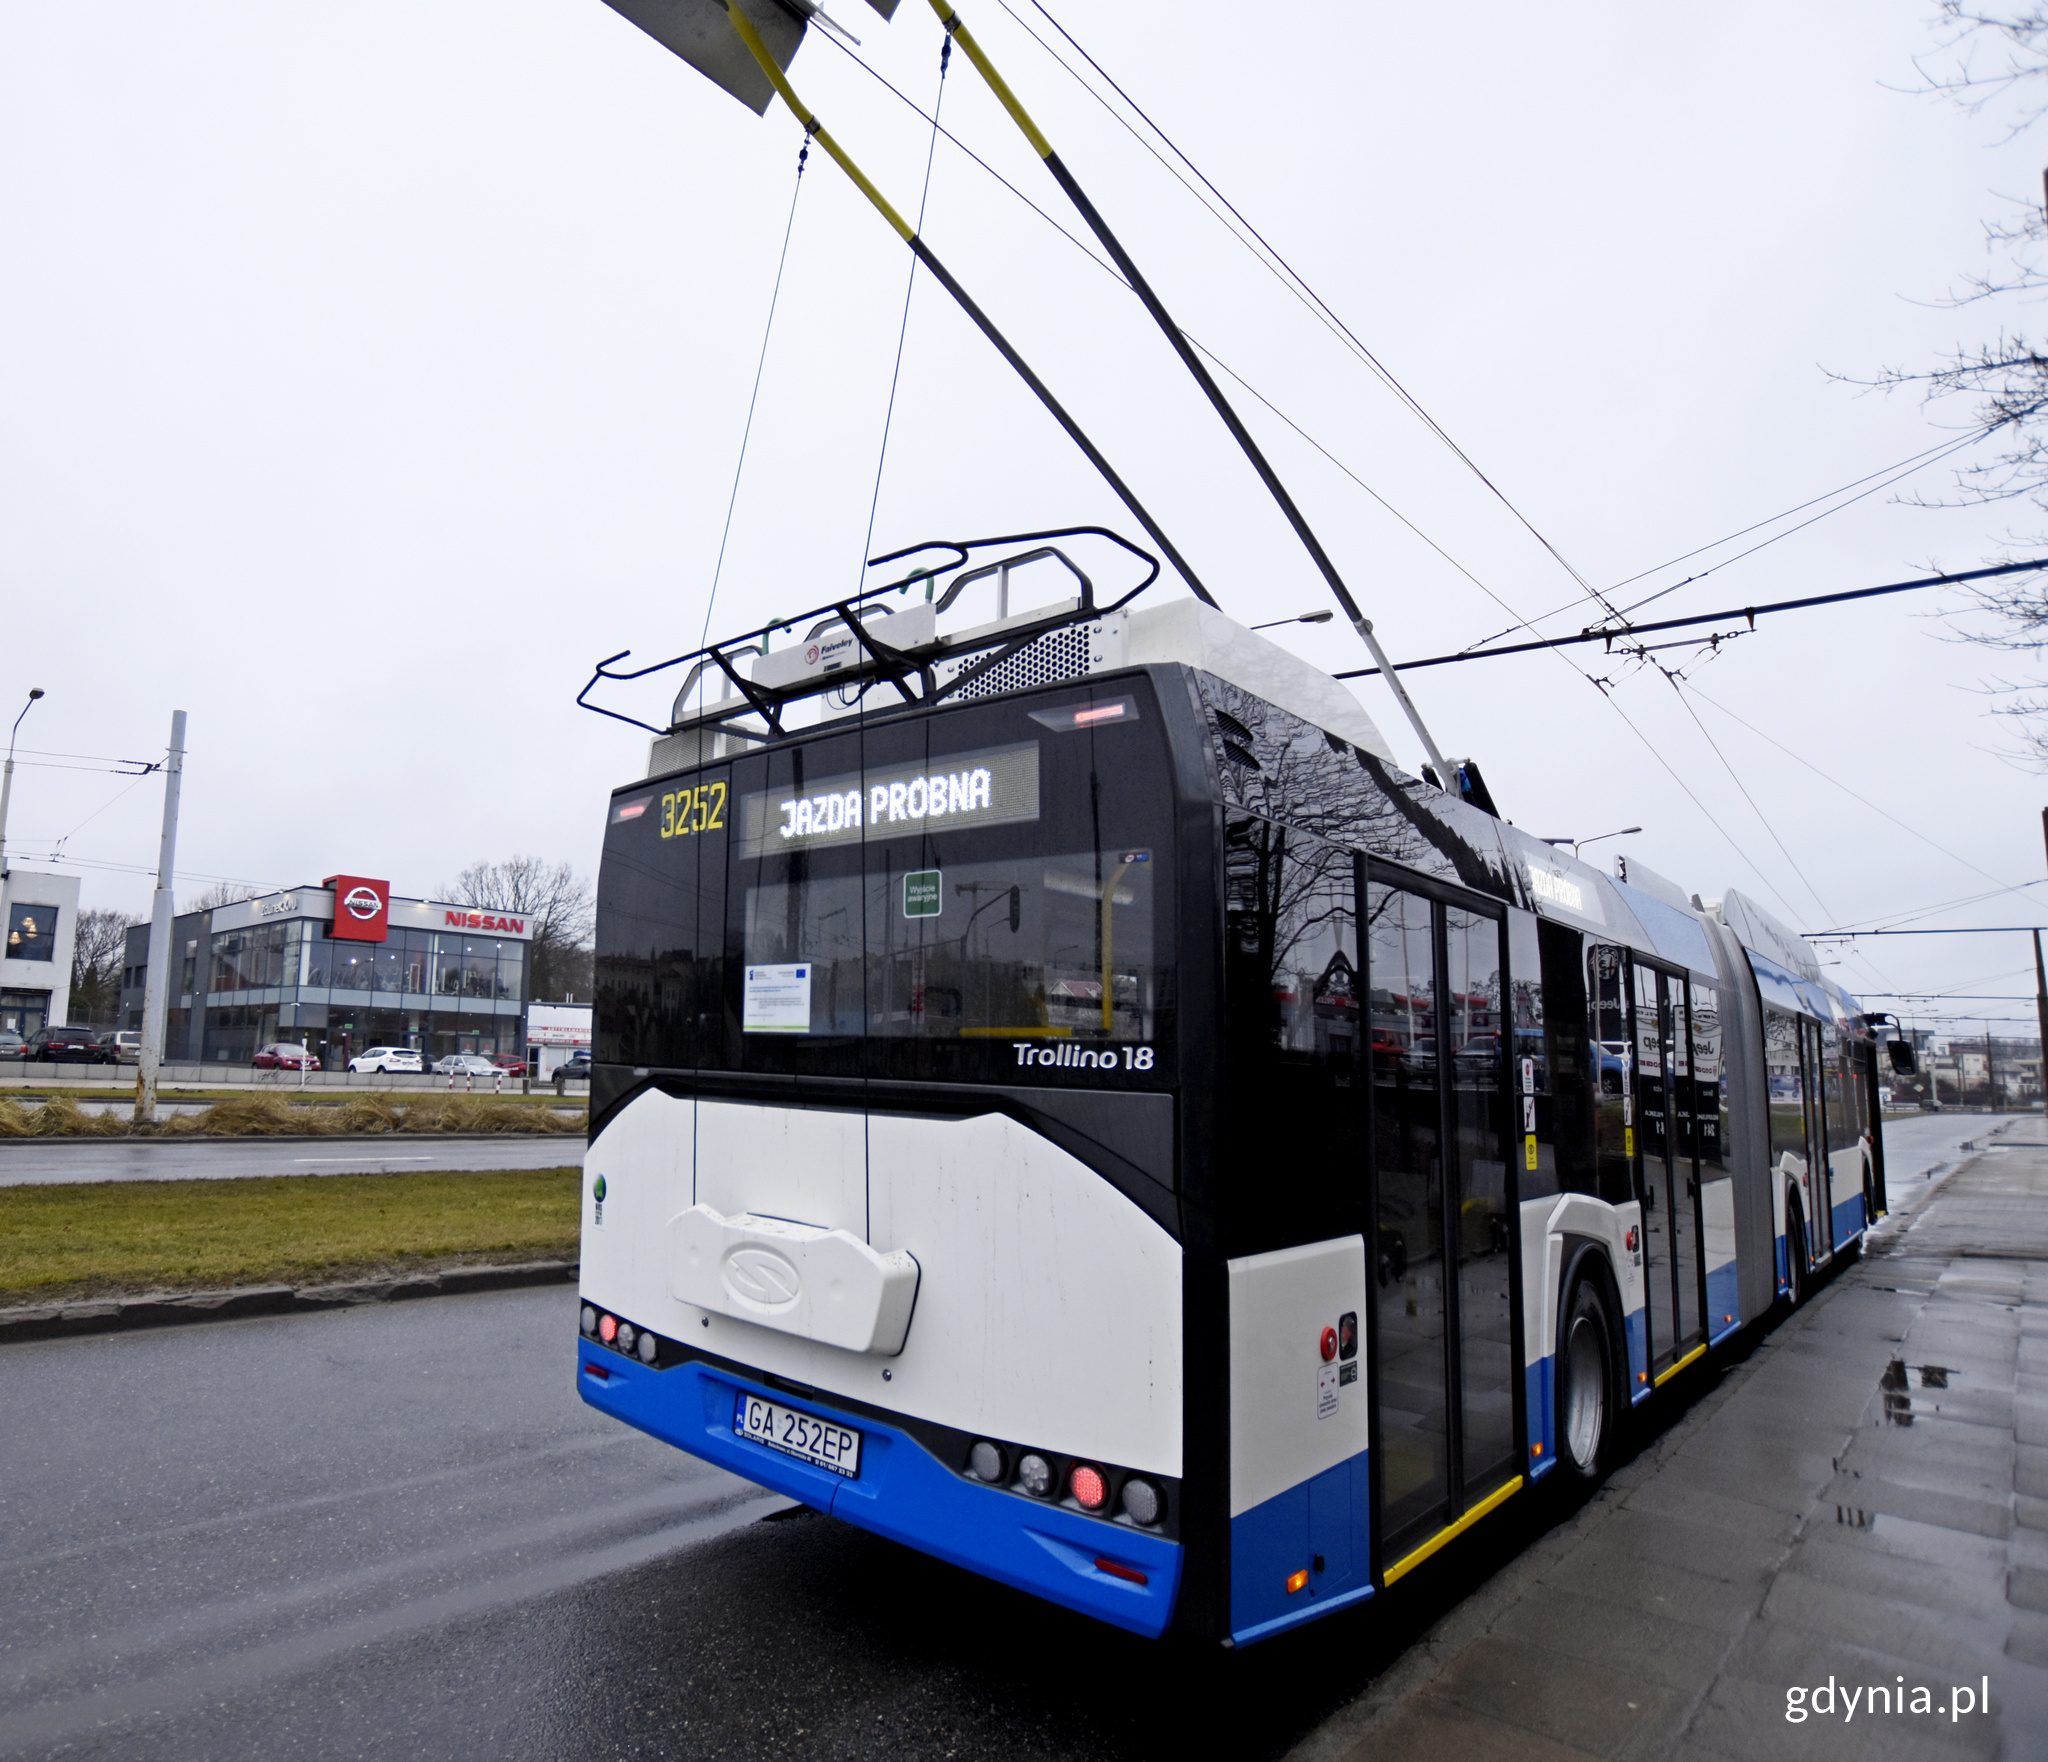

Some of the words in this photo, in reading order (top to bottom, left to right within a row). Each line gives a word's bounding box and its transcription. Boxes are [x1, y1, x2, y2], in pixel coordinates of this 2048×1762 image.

[821, 638, 853, 654] Faiveley
[661, 782, 726, 838] 3252
[780, 789, 862, 838] JAZDA
[349, 900, 379, 909] NISSAN
[445, 910, 524, 933] NISSAN
[1012, 1043, 1118, 1069] Trollino
[1122, 1046, 1154, 1070] 18
[736, 1413, 744, 1424] PL
[743, 1432, 765, 1445] SOLARIS
[749, 1401, 773, 1437] GA
[782, 1413, 852, 1462] 252EP
